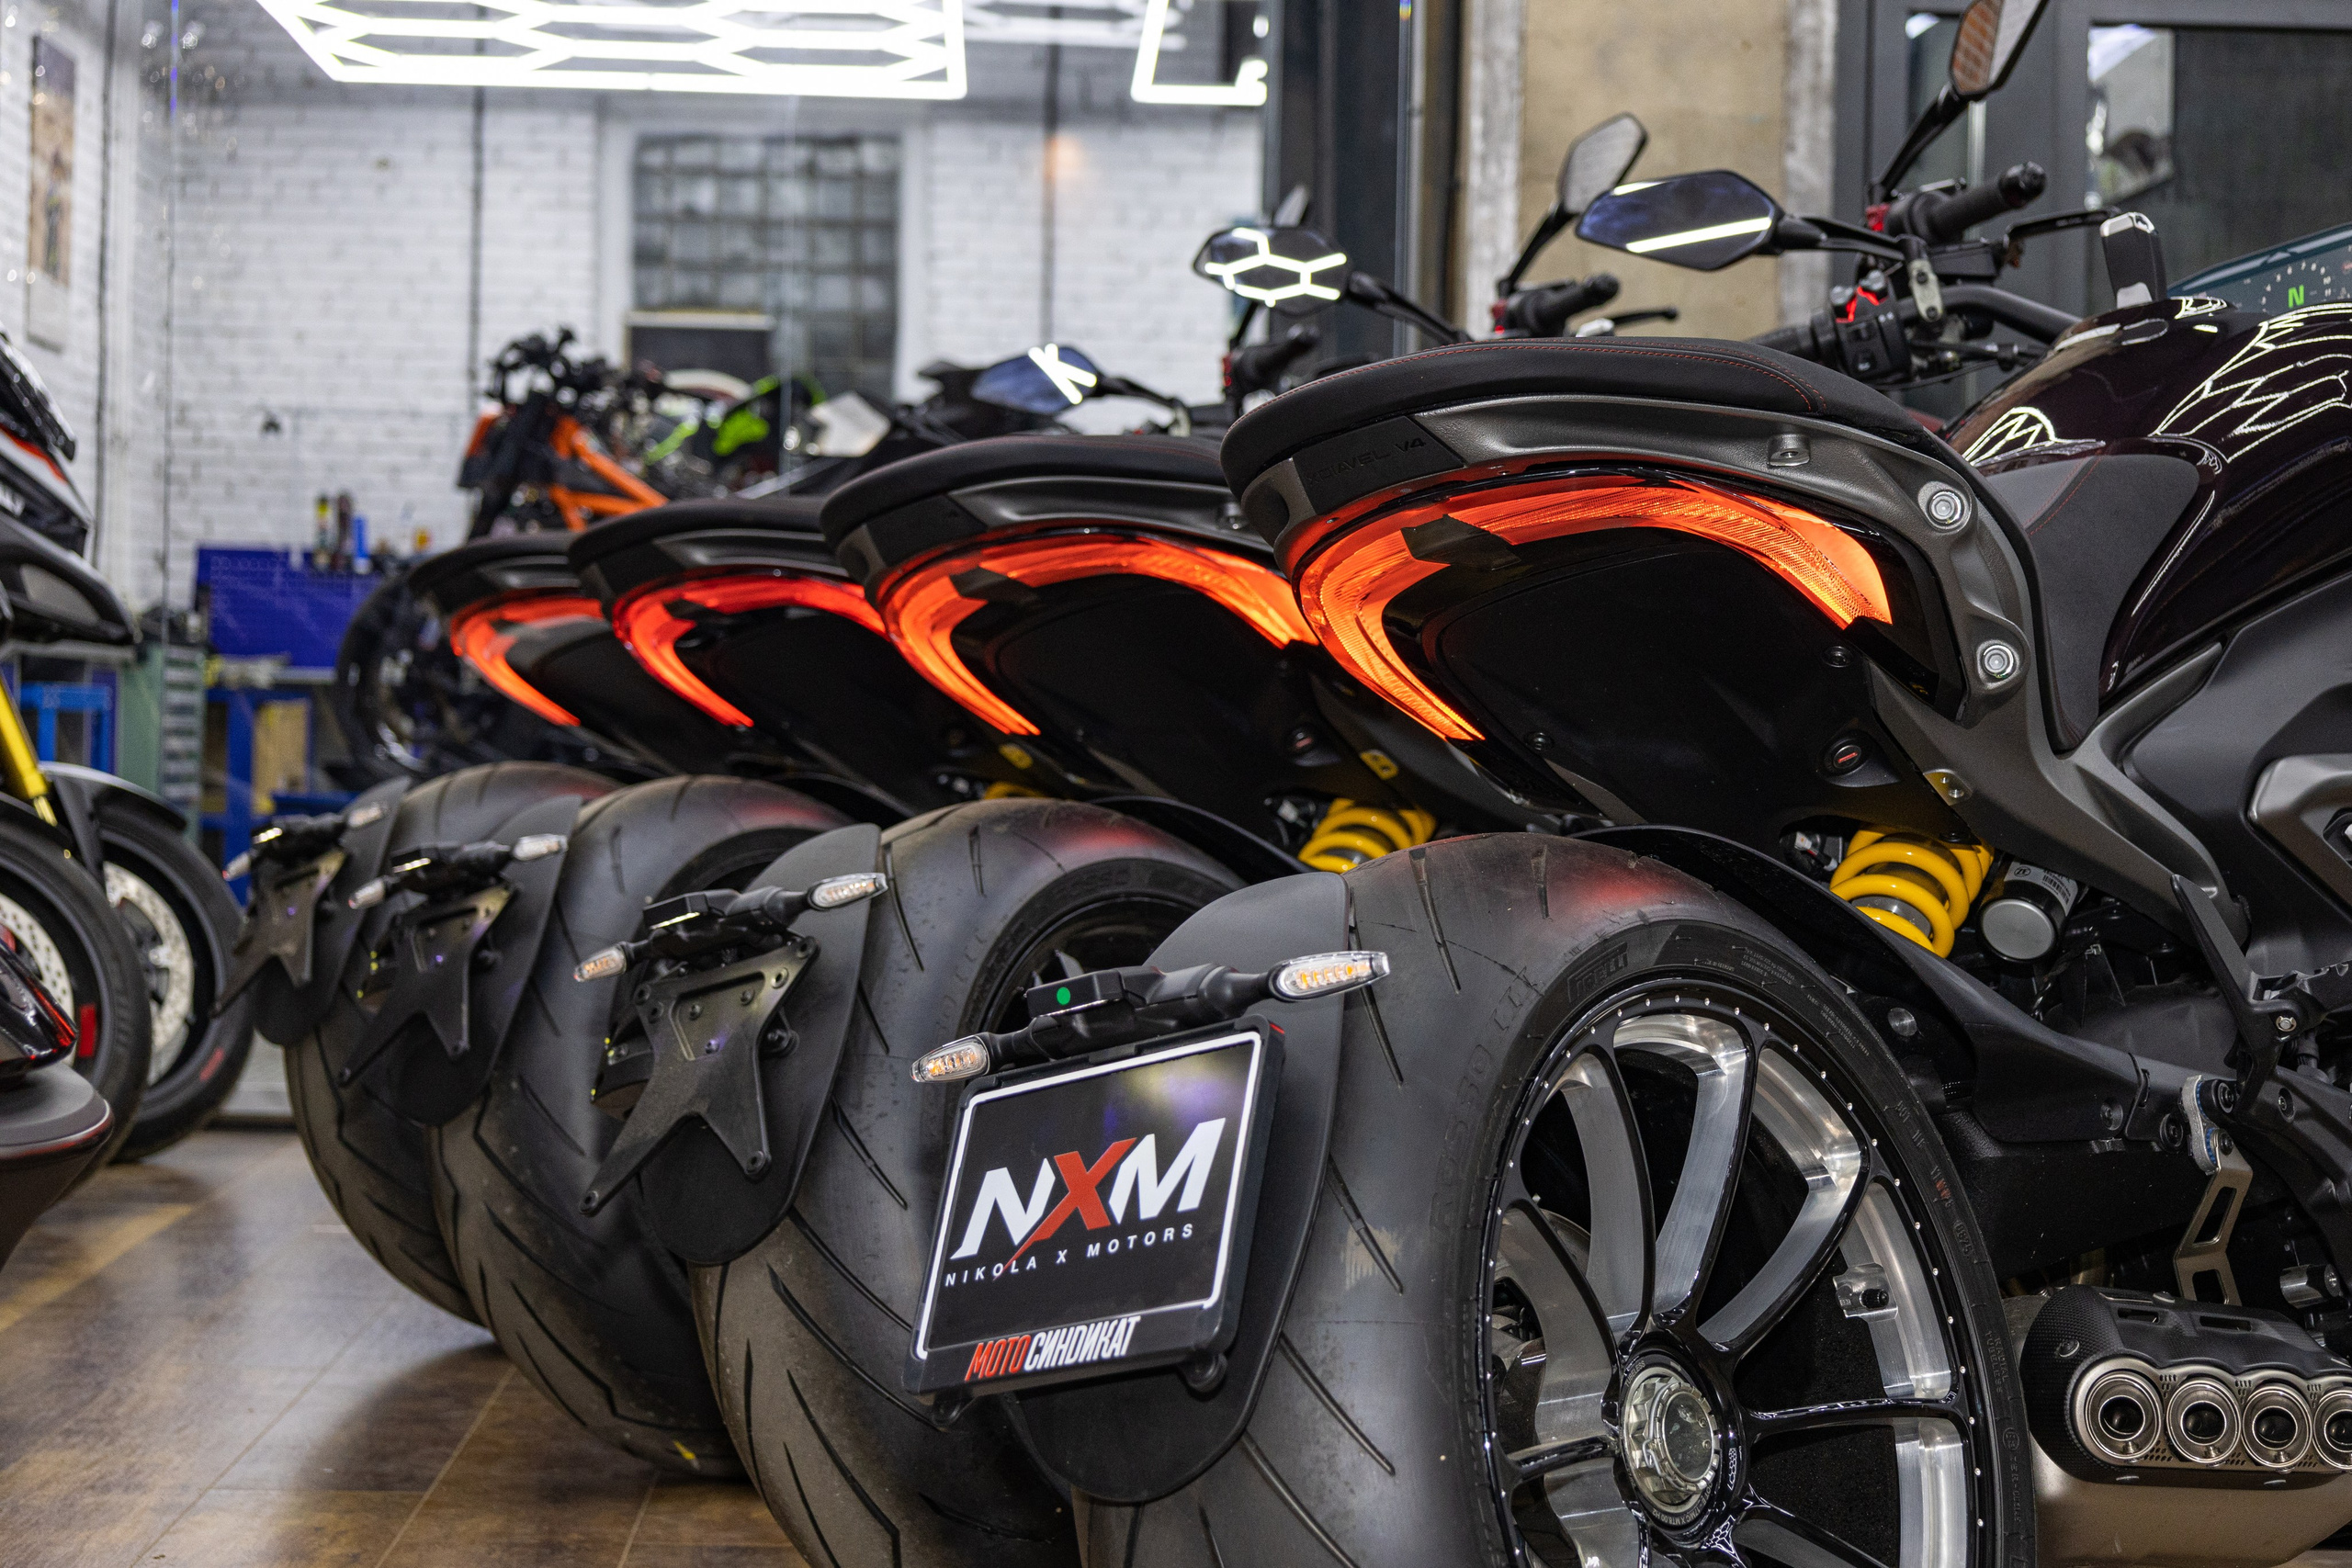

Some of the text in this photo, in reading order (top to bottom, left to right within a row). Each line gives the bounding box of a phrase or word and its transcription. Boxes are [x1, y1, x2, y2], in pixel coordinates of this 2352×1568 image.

[2288, 284, 2305, 309] N
[1395, 437, 1426, 453] V4
[950, 1118, 1227, 1263] NXM
[944, 1223, 1193, 1287] NIKOLA X MOTORS
[1624, 1359, 1645, 1388] TUBELESS
